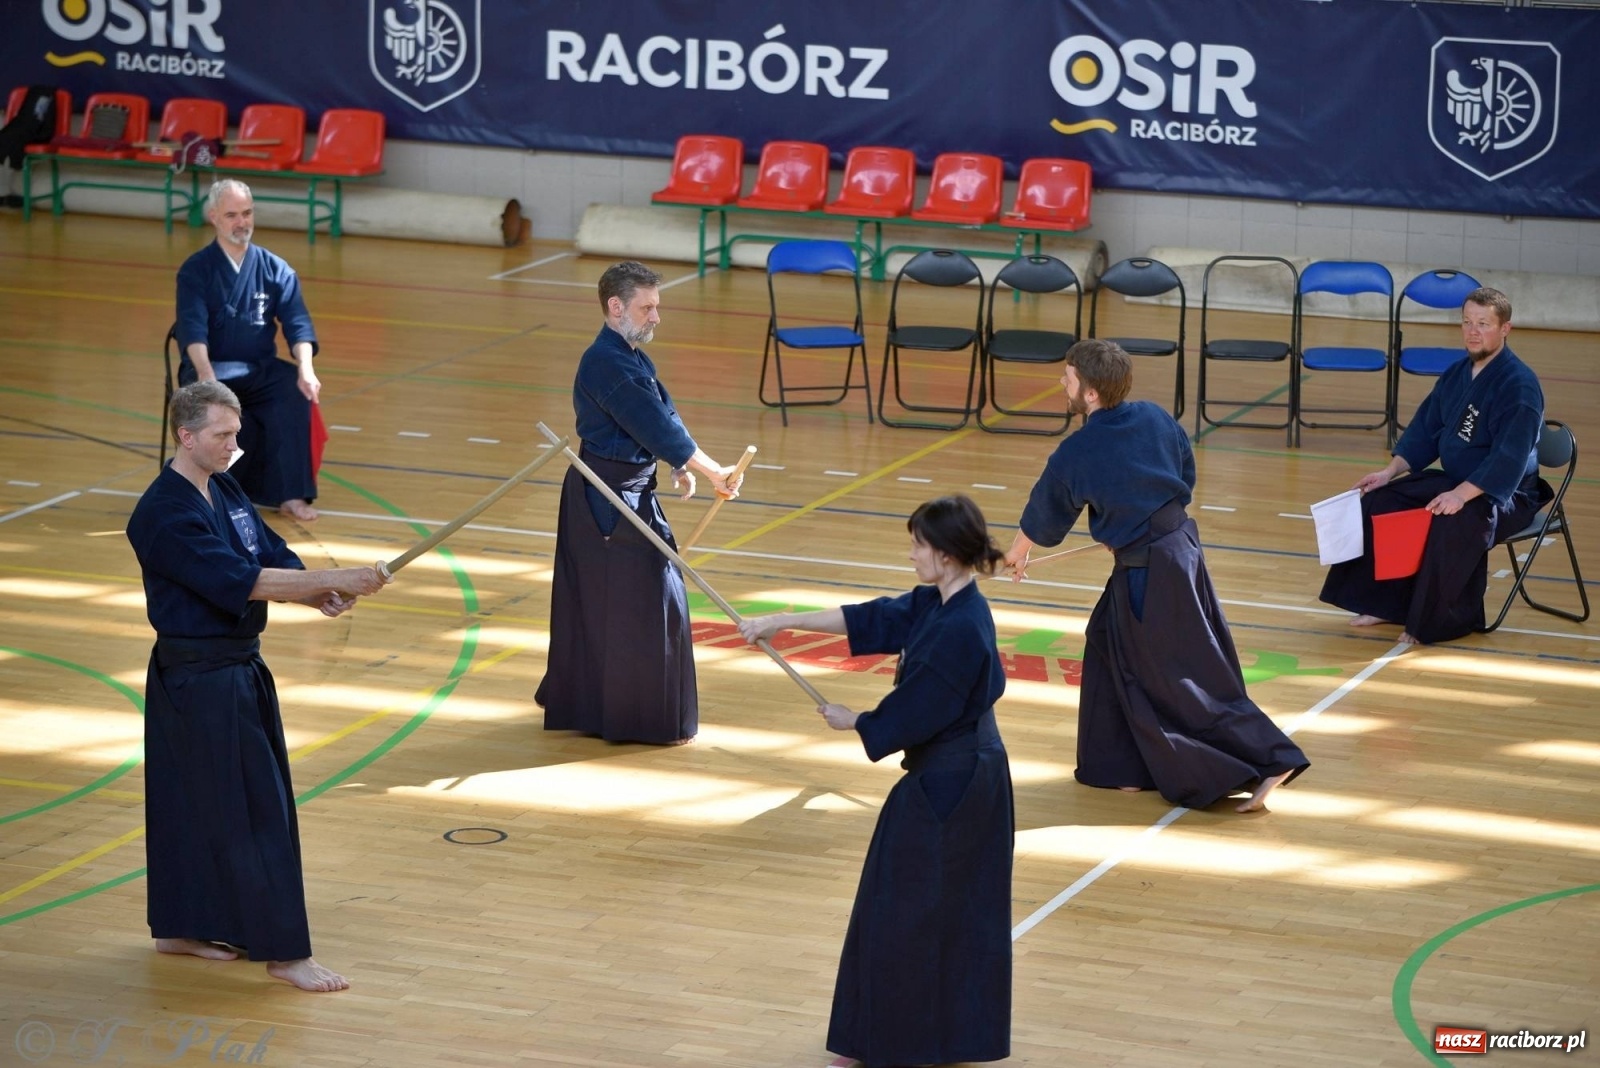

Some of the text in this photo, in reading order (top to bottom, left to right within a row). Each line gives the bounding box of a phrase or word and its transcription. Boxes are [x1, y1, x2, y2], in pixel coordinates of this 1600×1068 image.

[116, 51, 226, 79] RACIBÓRZ
[546, 23, 890, 100] RACIBÓRZ
[1129, 118, 1258, 148] RACIBÓRZ
